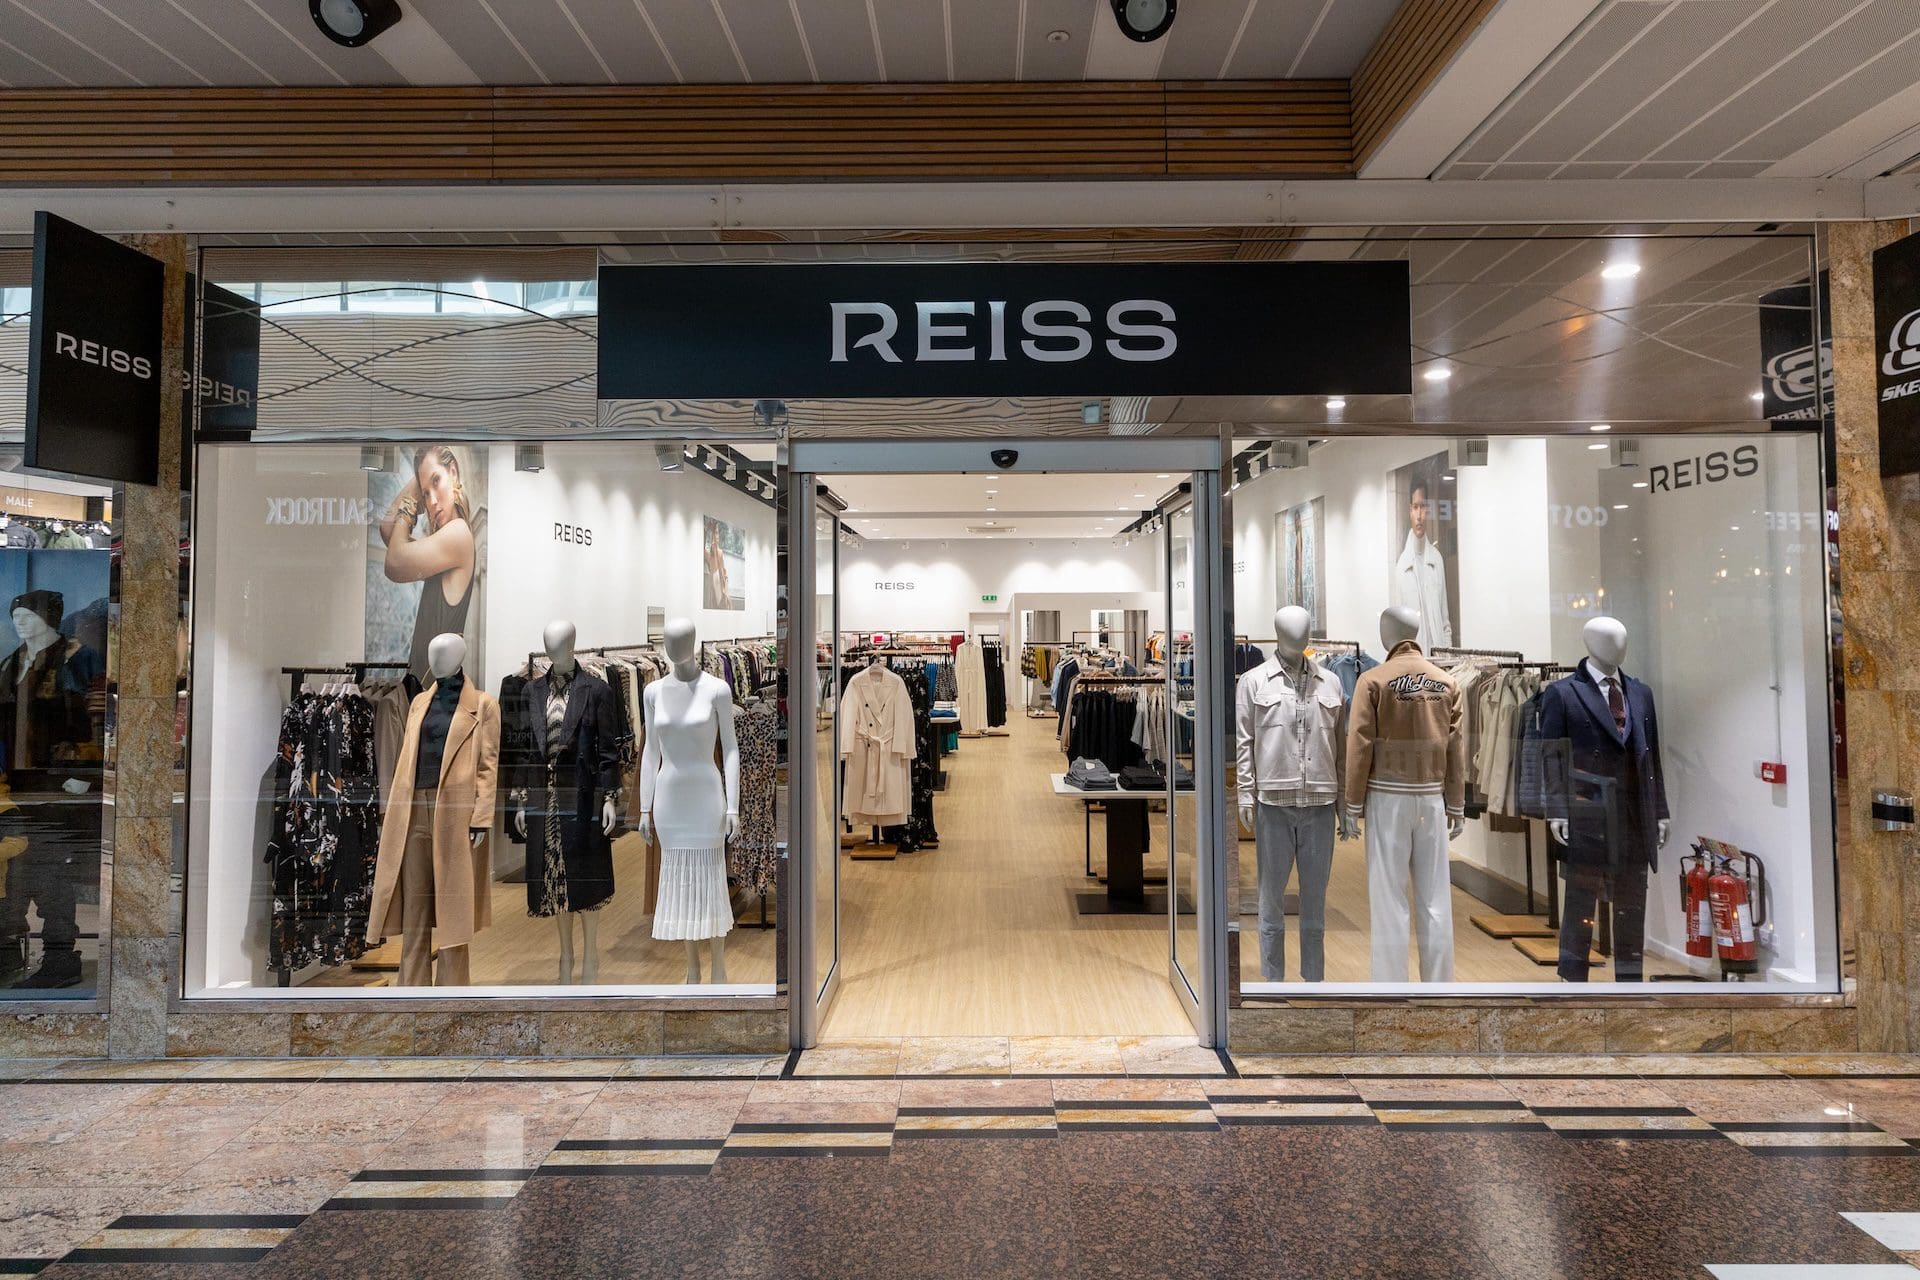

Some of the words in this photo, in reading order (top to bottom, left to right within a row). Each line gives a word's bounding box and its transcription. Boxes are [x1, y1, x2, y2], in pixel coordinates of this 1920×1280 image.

[830, 299, 1177, 362] REISS
[56, 331, 151, 379] REISS
[1881, 379, 1920, 402] SKE
[1650, 445, 1758, 494] REISS
[5, 495, 34, 509] MALE
[554, 522, 592, 546] REISS
[875, 582, 915, 590] REISS
